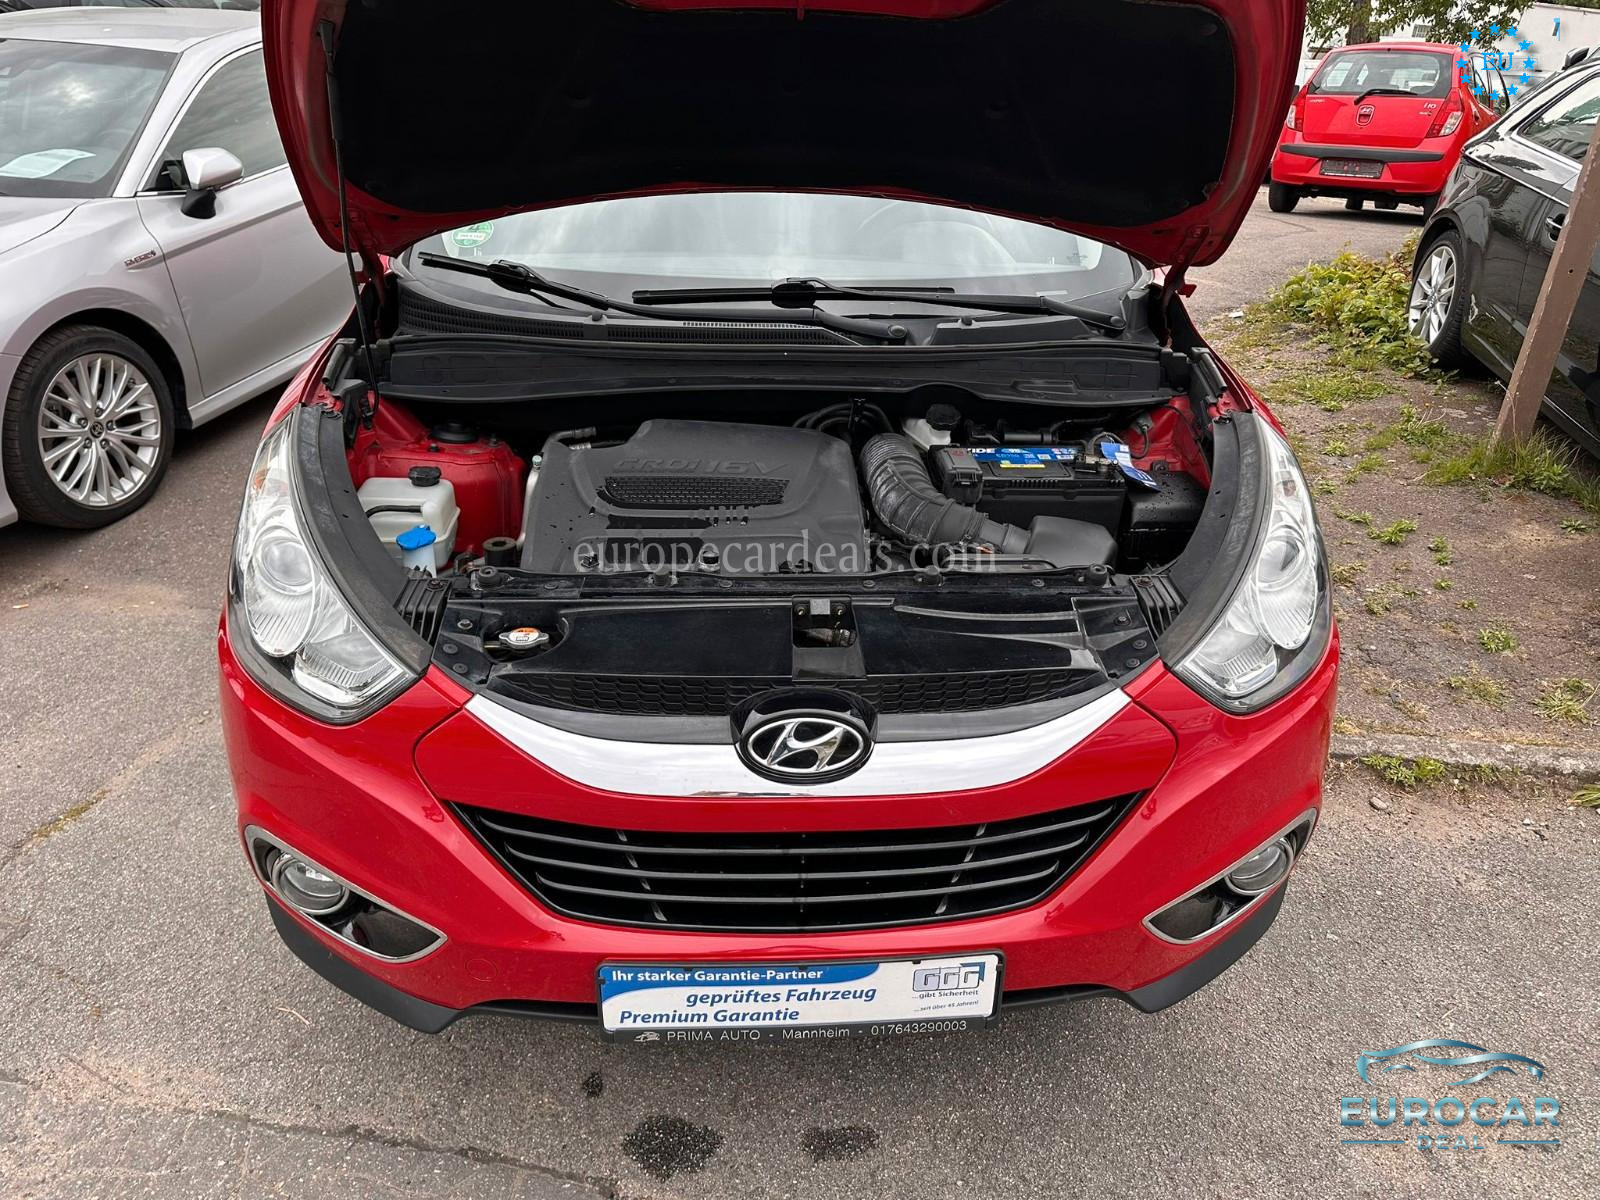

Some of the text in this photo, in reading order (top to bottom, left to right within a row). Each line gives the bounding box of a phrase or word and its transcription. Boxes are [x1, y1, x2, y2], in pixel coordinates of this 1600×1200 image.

[612, 968, 823, 982] Ihr starker Garantie-Partner
[686, 987, 877, 1007] geprüftes Fahrzeug
[938, 989, 979, 998] Sicherheit
[620, 1007, 800, 1024] Premium Garantie
[667, 1030, 713, 1041] PRIMA
[720, 1030, 761, 1041] AUTO
[782, 1028, 850, 1040] Mannheim
[870, 1020, 967, 1036] 017643290003
